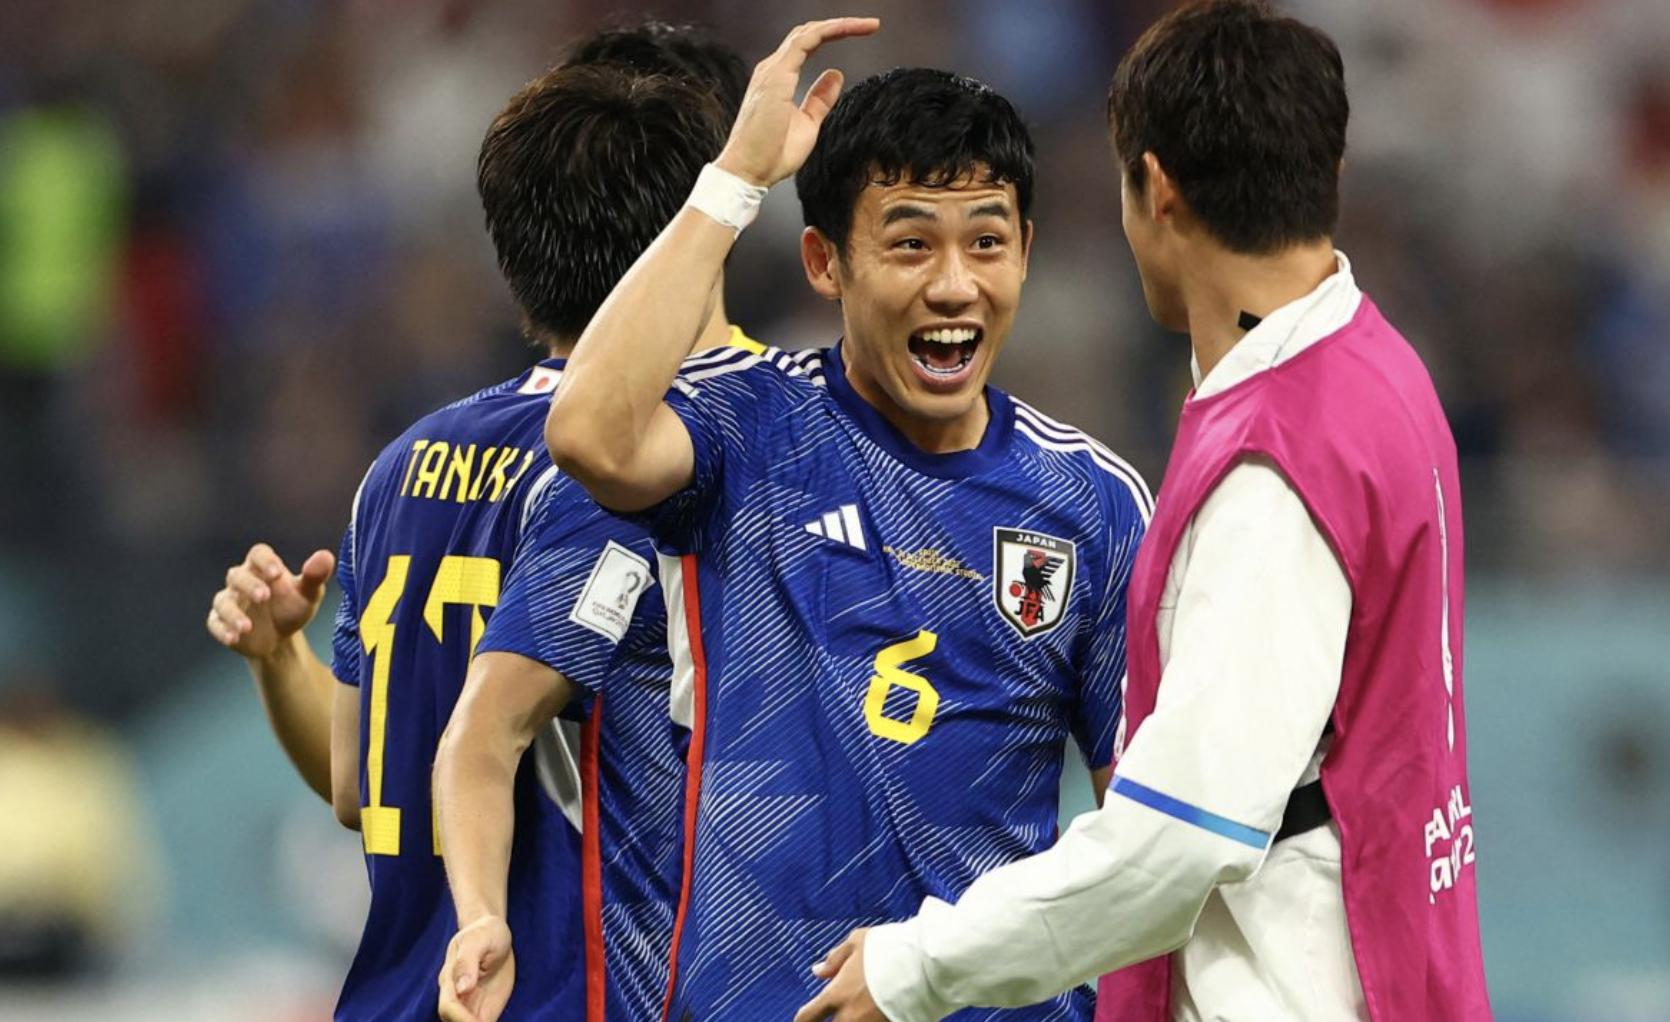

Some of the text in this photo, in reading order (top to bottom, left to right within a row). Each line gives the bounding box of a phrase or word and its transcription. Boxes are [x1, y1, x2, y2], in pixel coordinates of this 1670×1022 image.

[1016, 533, 1057, 549] JAPAN
[1014, 600, 1045, 622] JFA
[863, 629, 941, 746] 6
